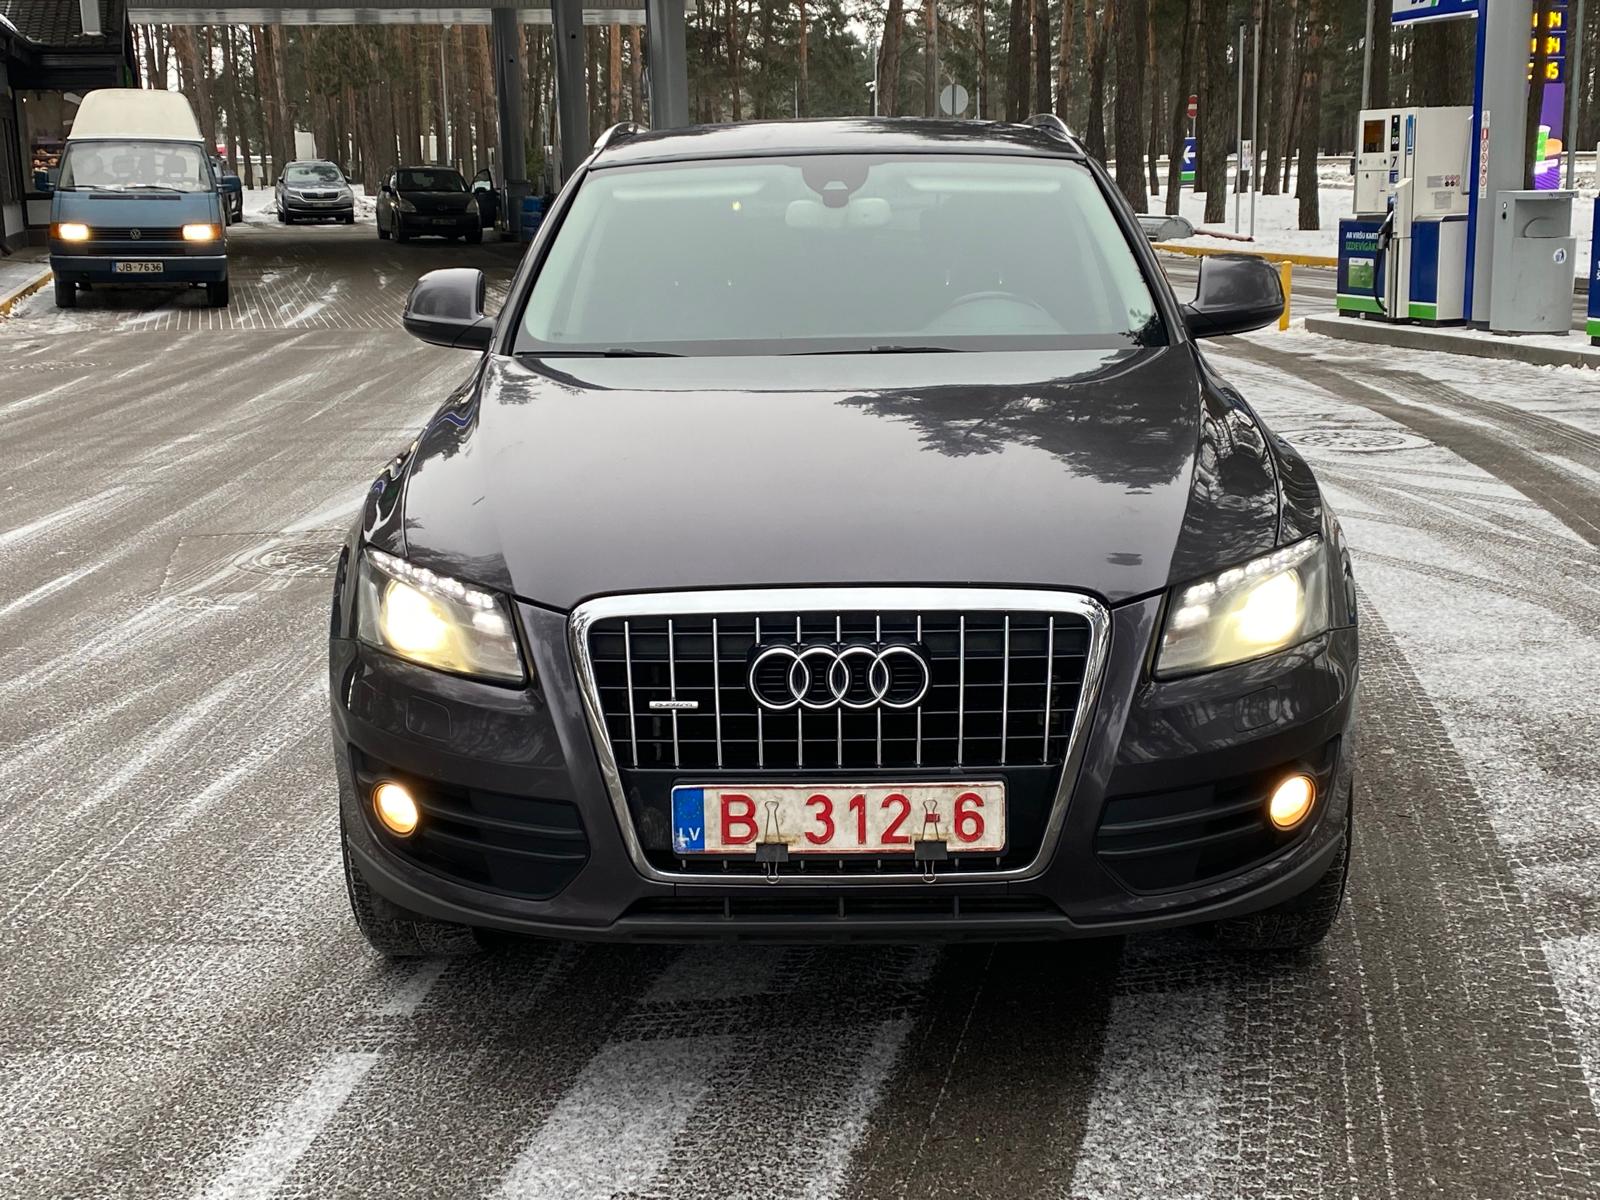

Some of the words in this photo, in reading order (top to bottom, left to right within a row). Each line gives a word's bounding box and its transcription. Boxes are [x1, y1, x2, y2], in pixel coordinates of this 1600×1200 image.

[1391, 156, 1398, 168] 7
[118, 263, 162, 271] JB-7636
[720, 793, 759, 845] B
[679, 826, 701, 844] LV
